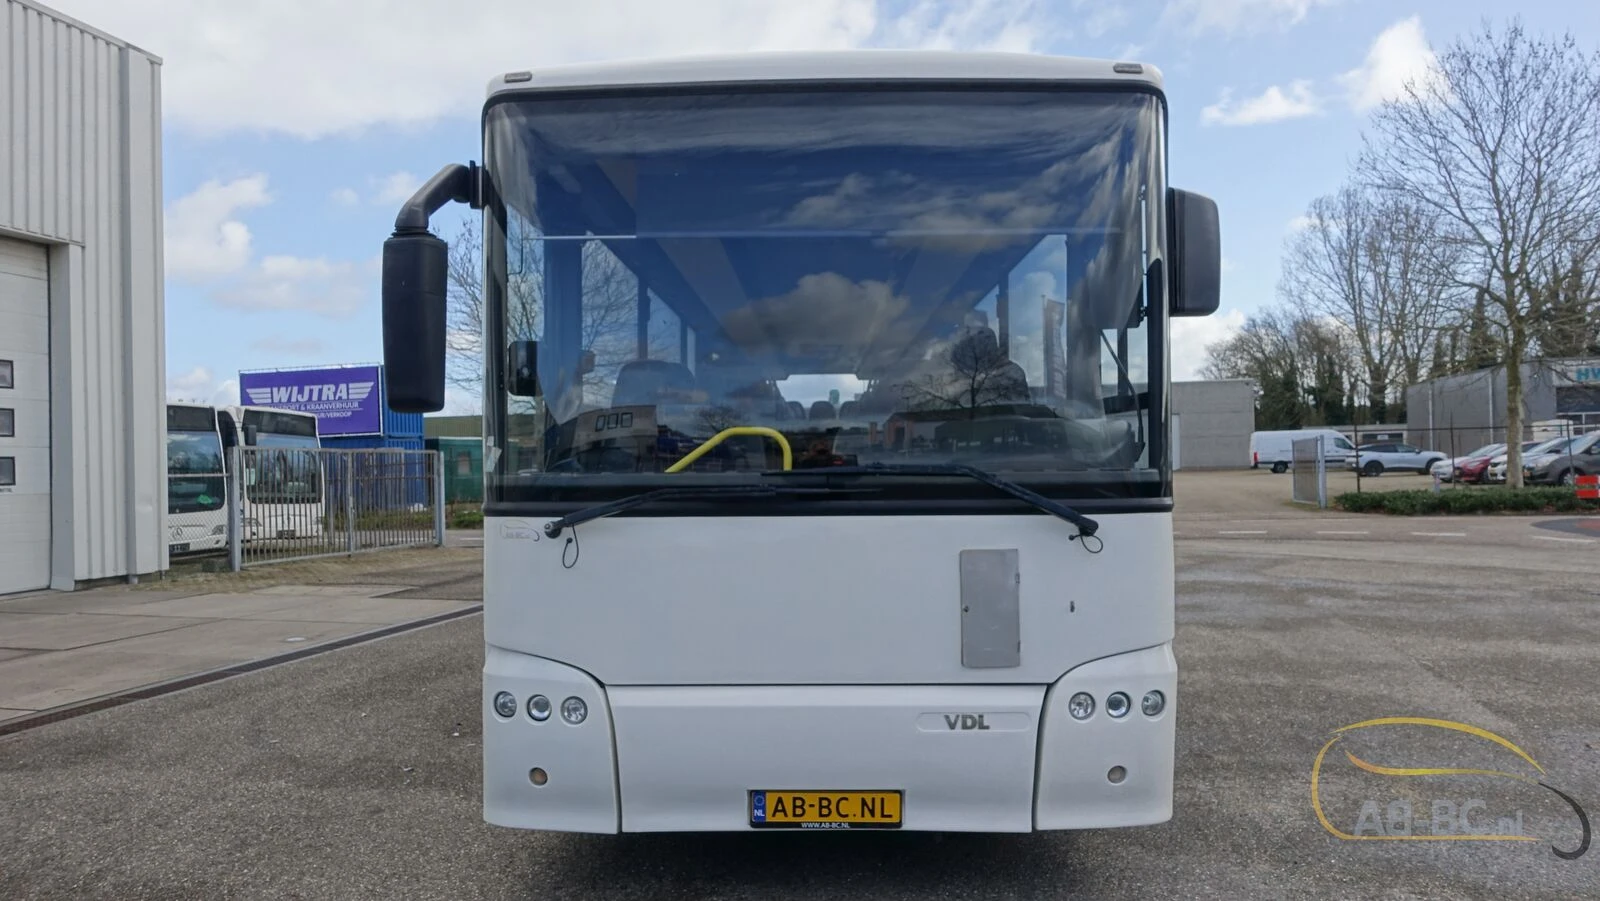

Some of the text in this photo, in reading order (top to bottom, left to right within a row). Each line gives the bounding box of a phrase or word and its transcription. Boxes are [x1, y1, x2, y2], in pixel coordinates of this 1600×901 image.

[272, 383, 349, 403] WIJTRA
[943, 714, 991, 731] VDL
[754, 796, 893, 819] NL AB-BC.NL
